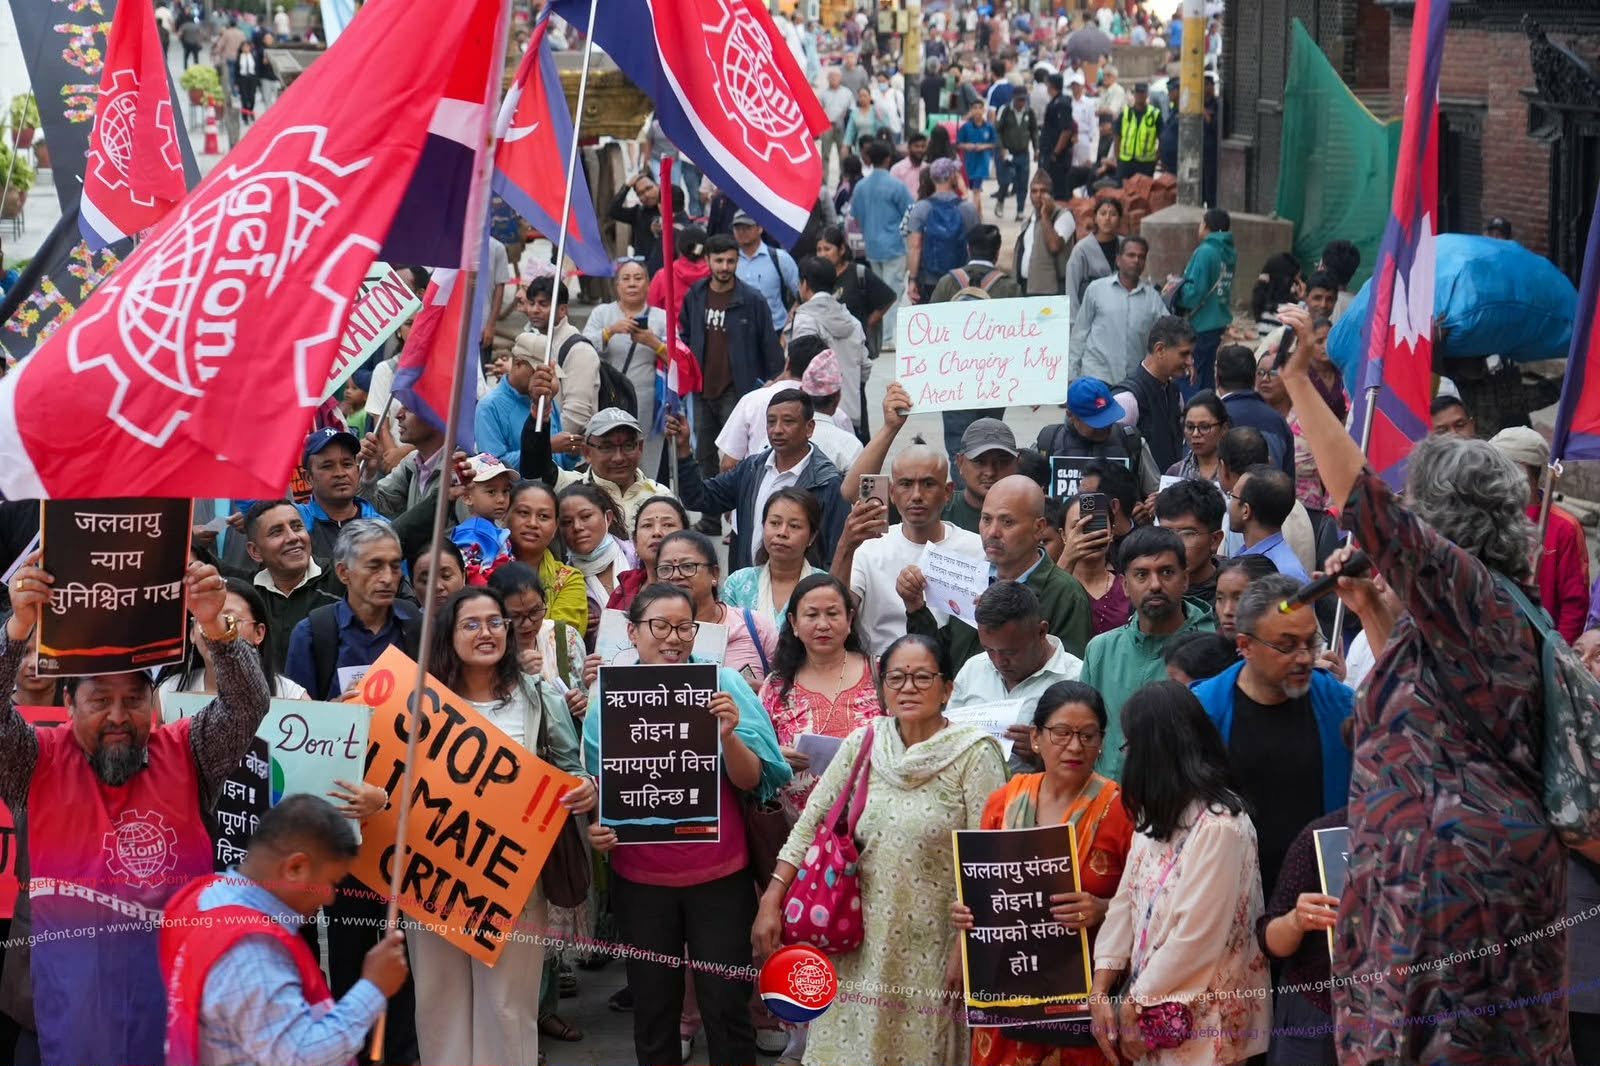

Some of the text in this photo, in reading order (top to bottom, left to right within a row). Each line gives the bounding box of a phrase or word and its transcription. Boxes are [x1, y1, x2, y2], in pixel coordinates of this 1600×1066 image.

[908, 310, 1042, 345] Our Climate
[901, 345, 1062, 382] Is Changing Why
[918, 382, 964, 405] Arent
[976, 380, 1001, 400] We
[1057, 479, 1081, 496] PA
[74, 512, 162, 538] जलवायु
[90, 551, 144, 571] न्याय
[50, 582, 138, 615] सुनिश्चित
[605, 683, 713, 708] ऋणको बोझ
[274, 713, 360, 759] Don't
[394, 686, 522, 798] STOP
[629, 718, 675, 743] होइन
[603, 750, 717, 779] न्यायपूर्ण वित्त
[620, 784, 685, 808] चाहिन्छ
[962, 856, 1071, 884] जलवायु संकट
[379, 844, 513, 952] CRIME
[970, 919, 1027, 944] न्यायको
